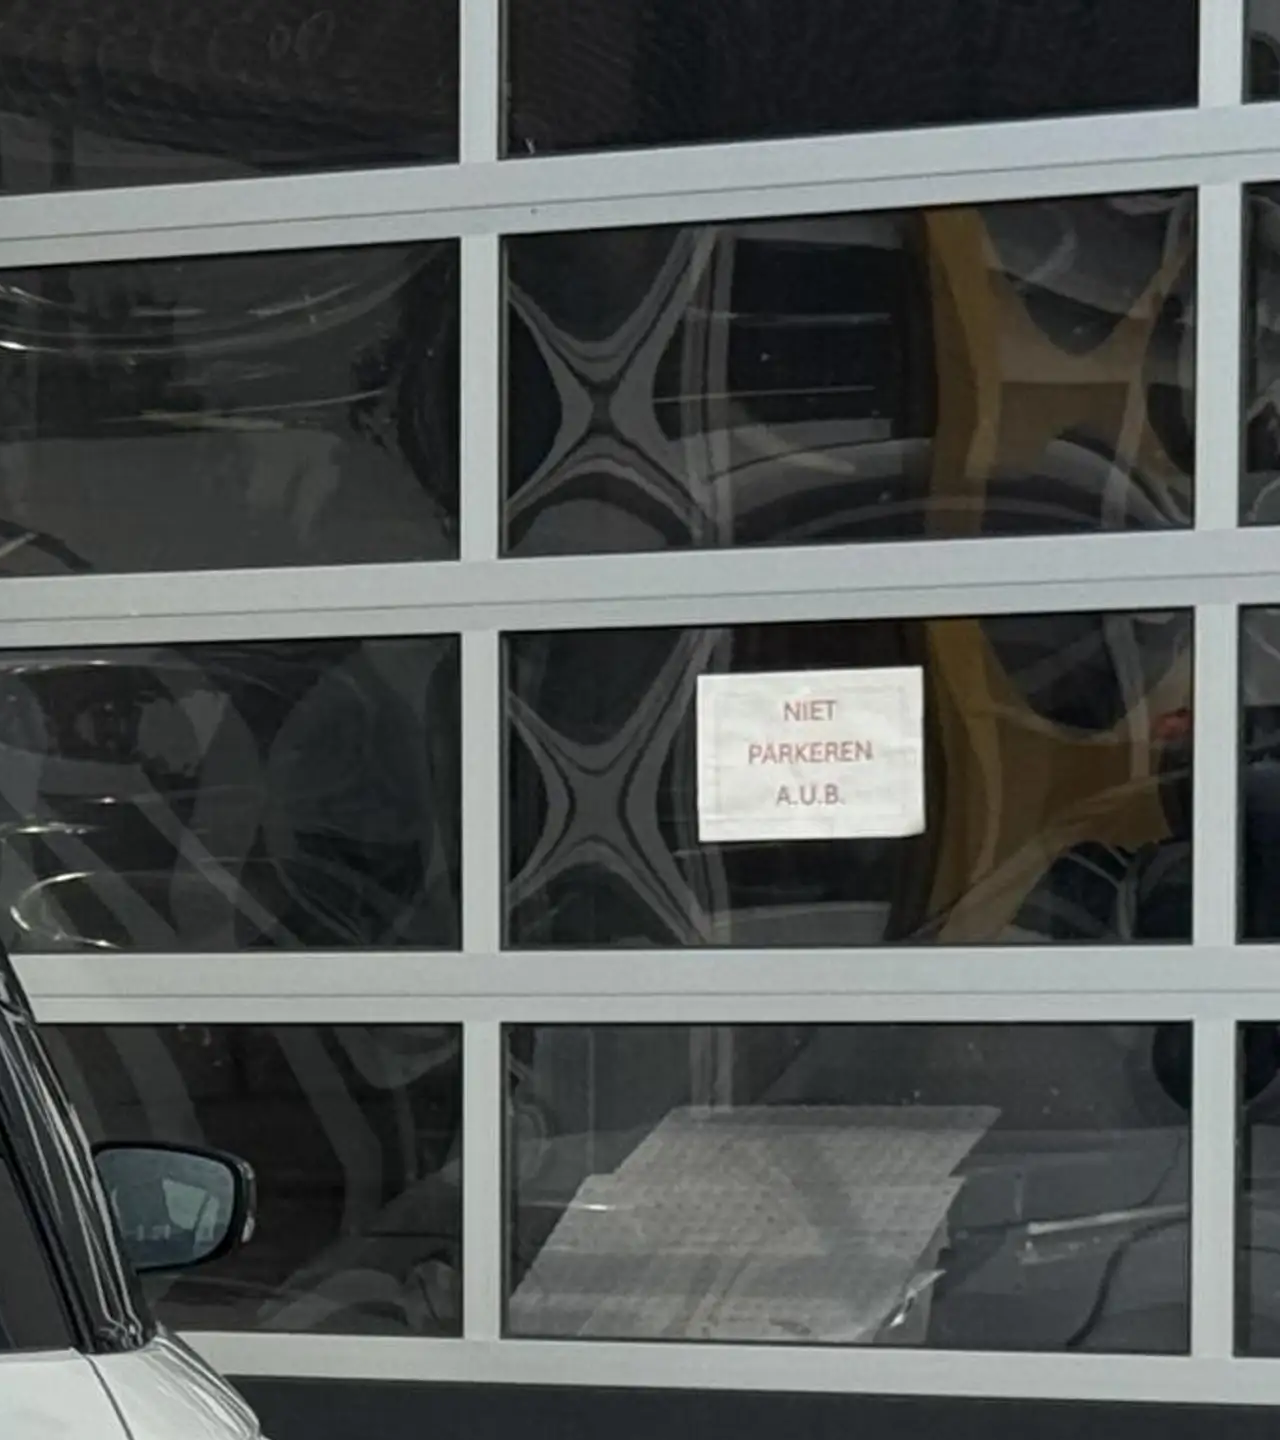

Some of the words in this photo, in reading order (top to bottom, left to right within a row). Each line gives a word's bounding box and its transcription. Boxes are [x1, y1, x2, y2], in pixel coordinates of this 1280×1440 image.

[784, 699, 837, 722] NIET
[748, 740, 874, 765] PARKEREN
[776, 783, 846, 807] A.U.B.
